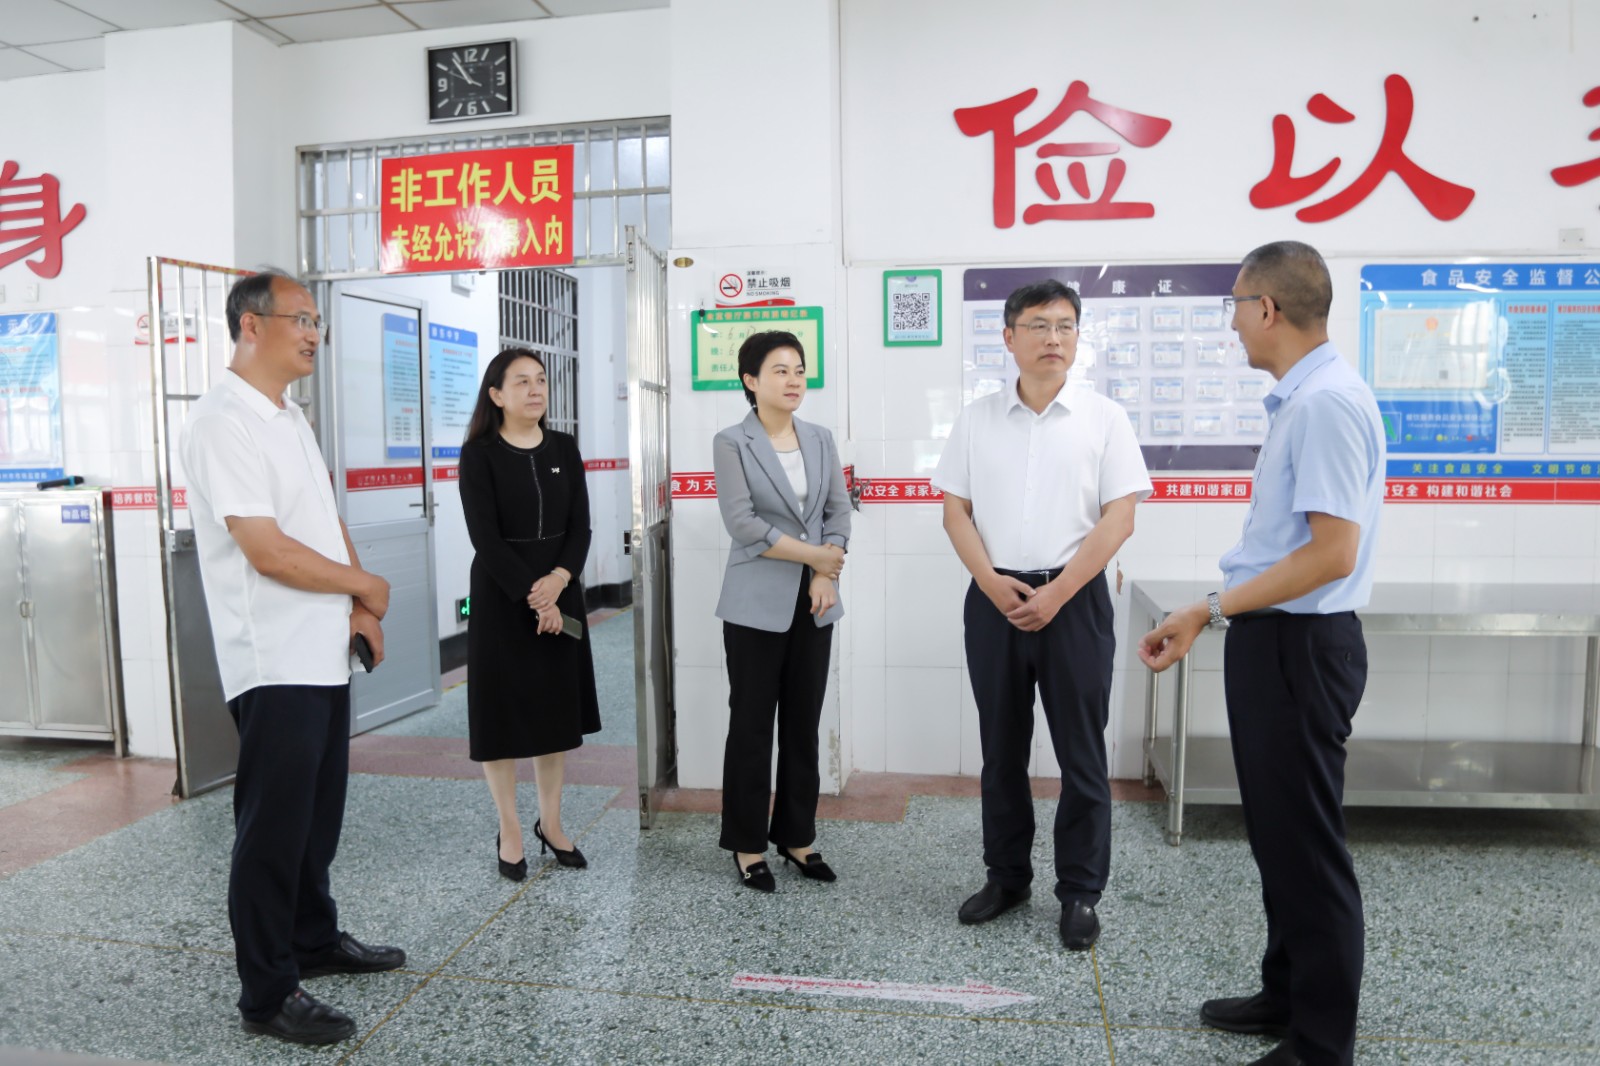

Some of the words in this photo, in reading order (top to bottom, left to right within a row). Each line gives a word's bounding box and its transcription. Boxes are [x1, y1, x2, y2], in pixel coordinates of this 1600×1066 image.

[464, 48, 478, 63] 12
[437, 78, 448, 92] 9
[496, 71, 506, 86] 3
[467, 101, 477, 115] 6
[390, 158, 562, 213] 非工作人员
[747, 277, 790, 288] 禁止吸烟
[1532, 463, 1600, 475] 文明节俭
[1427, 484, 1512, 498] 构建和谐社会
